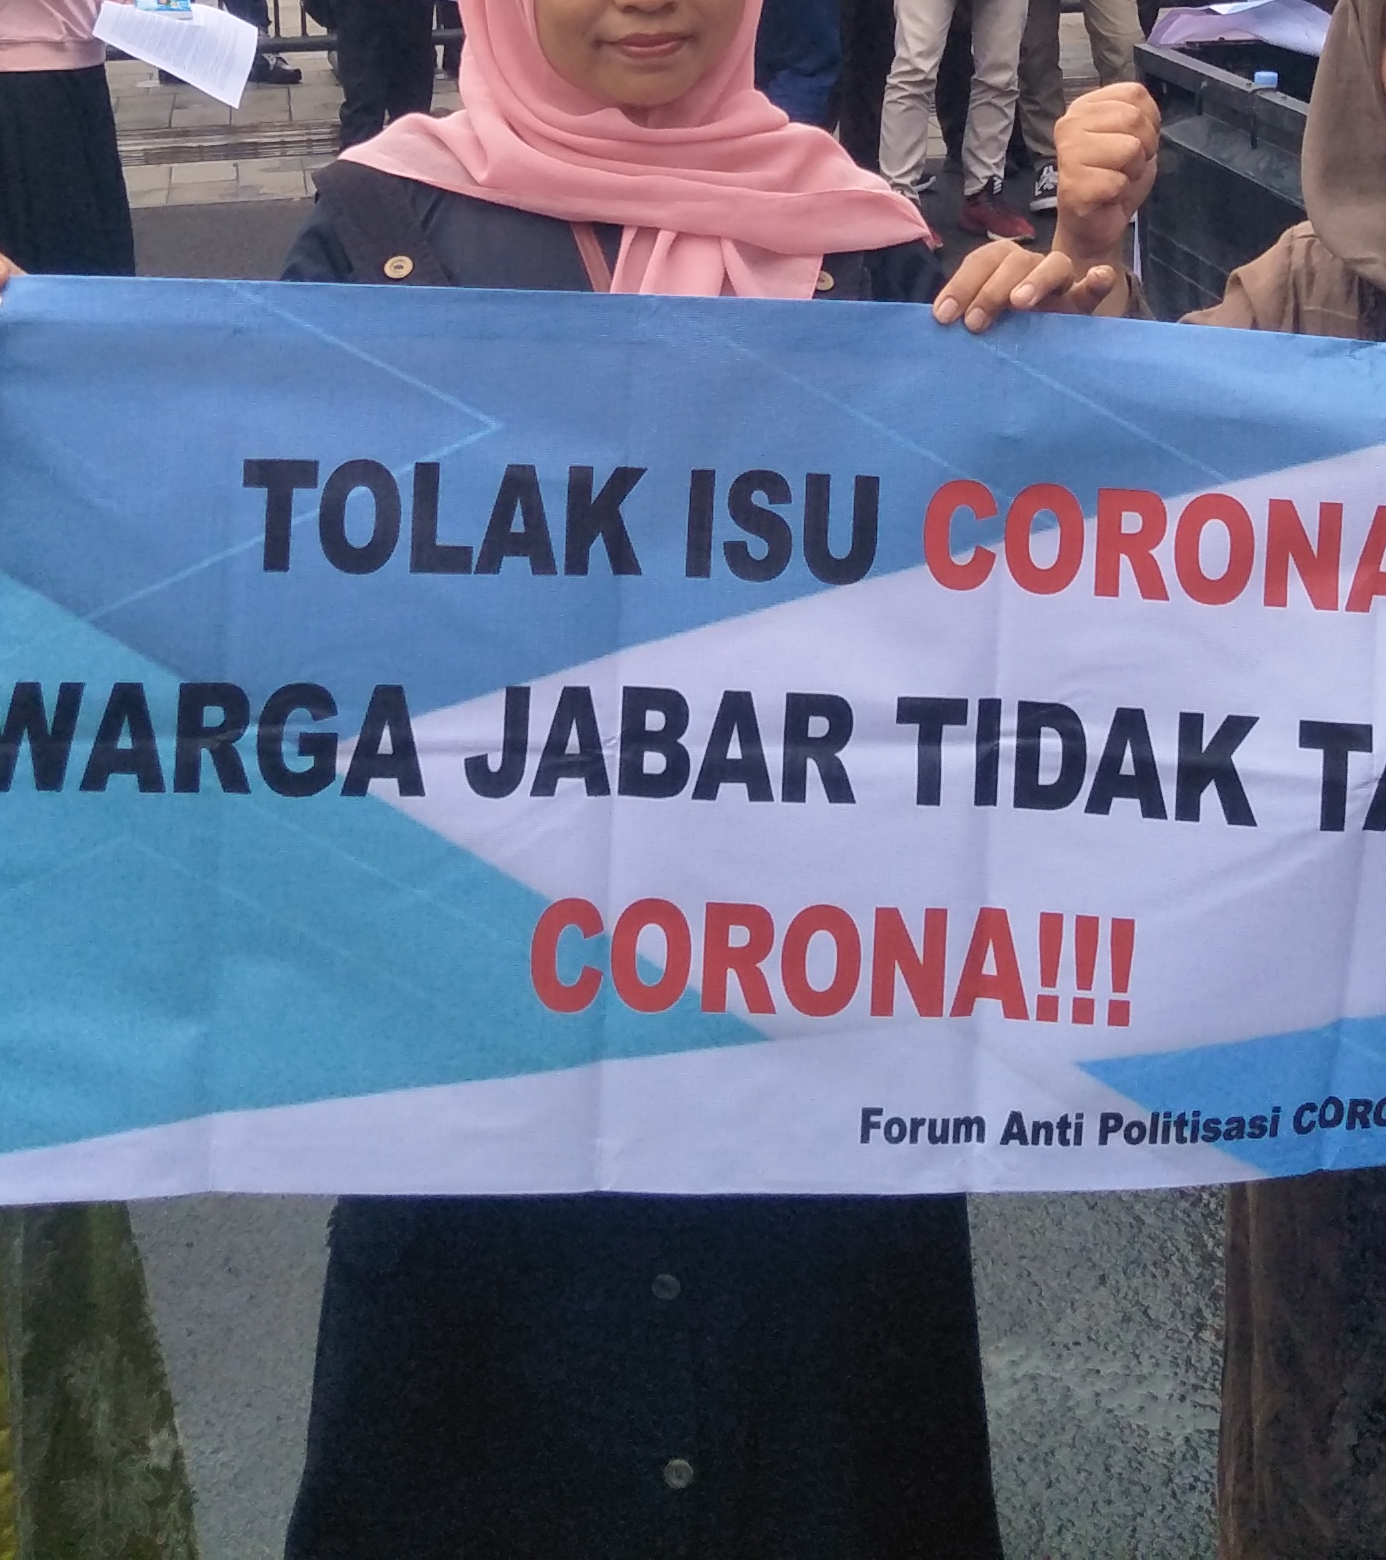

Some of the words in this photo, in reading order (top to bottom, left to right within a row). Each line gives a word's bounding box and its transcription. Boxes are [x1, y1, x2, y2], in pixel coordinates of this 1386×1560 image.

[244, 459, 647, 575] TOLAK
[686, 470, 879, 584] ISU
[465, 687, 855, 803] JABAR
[897, 698, 1258, 826] TIDAK
[532, 899, 1134, 1026] CORONA!!!
[861, 1107, 985, 1144] Forum
[1000, 1112, 1083, 1146] Anti
[1099, 1106, 1281, 1145] Politisasi
